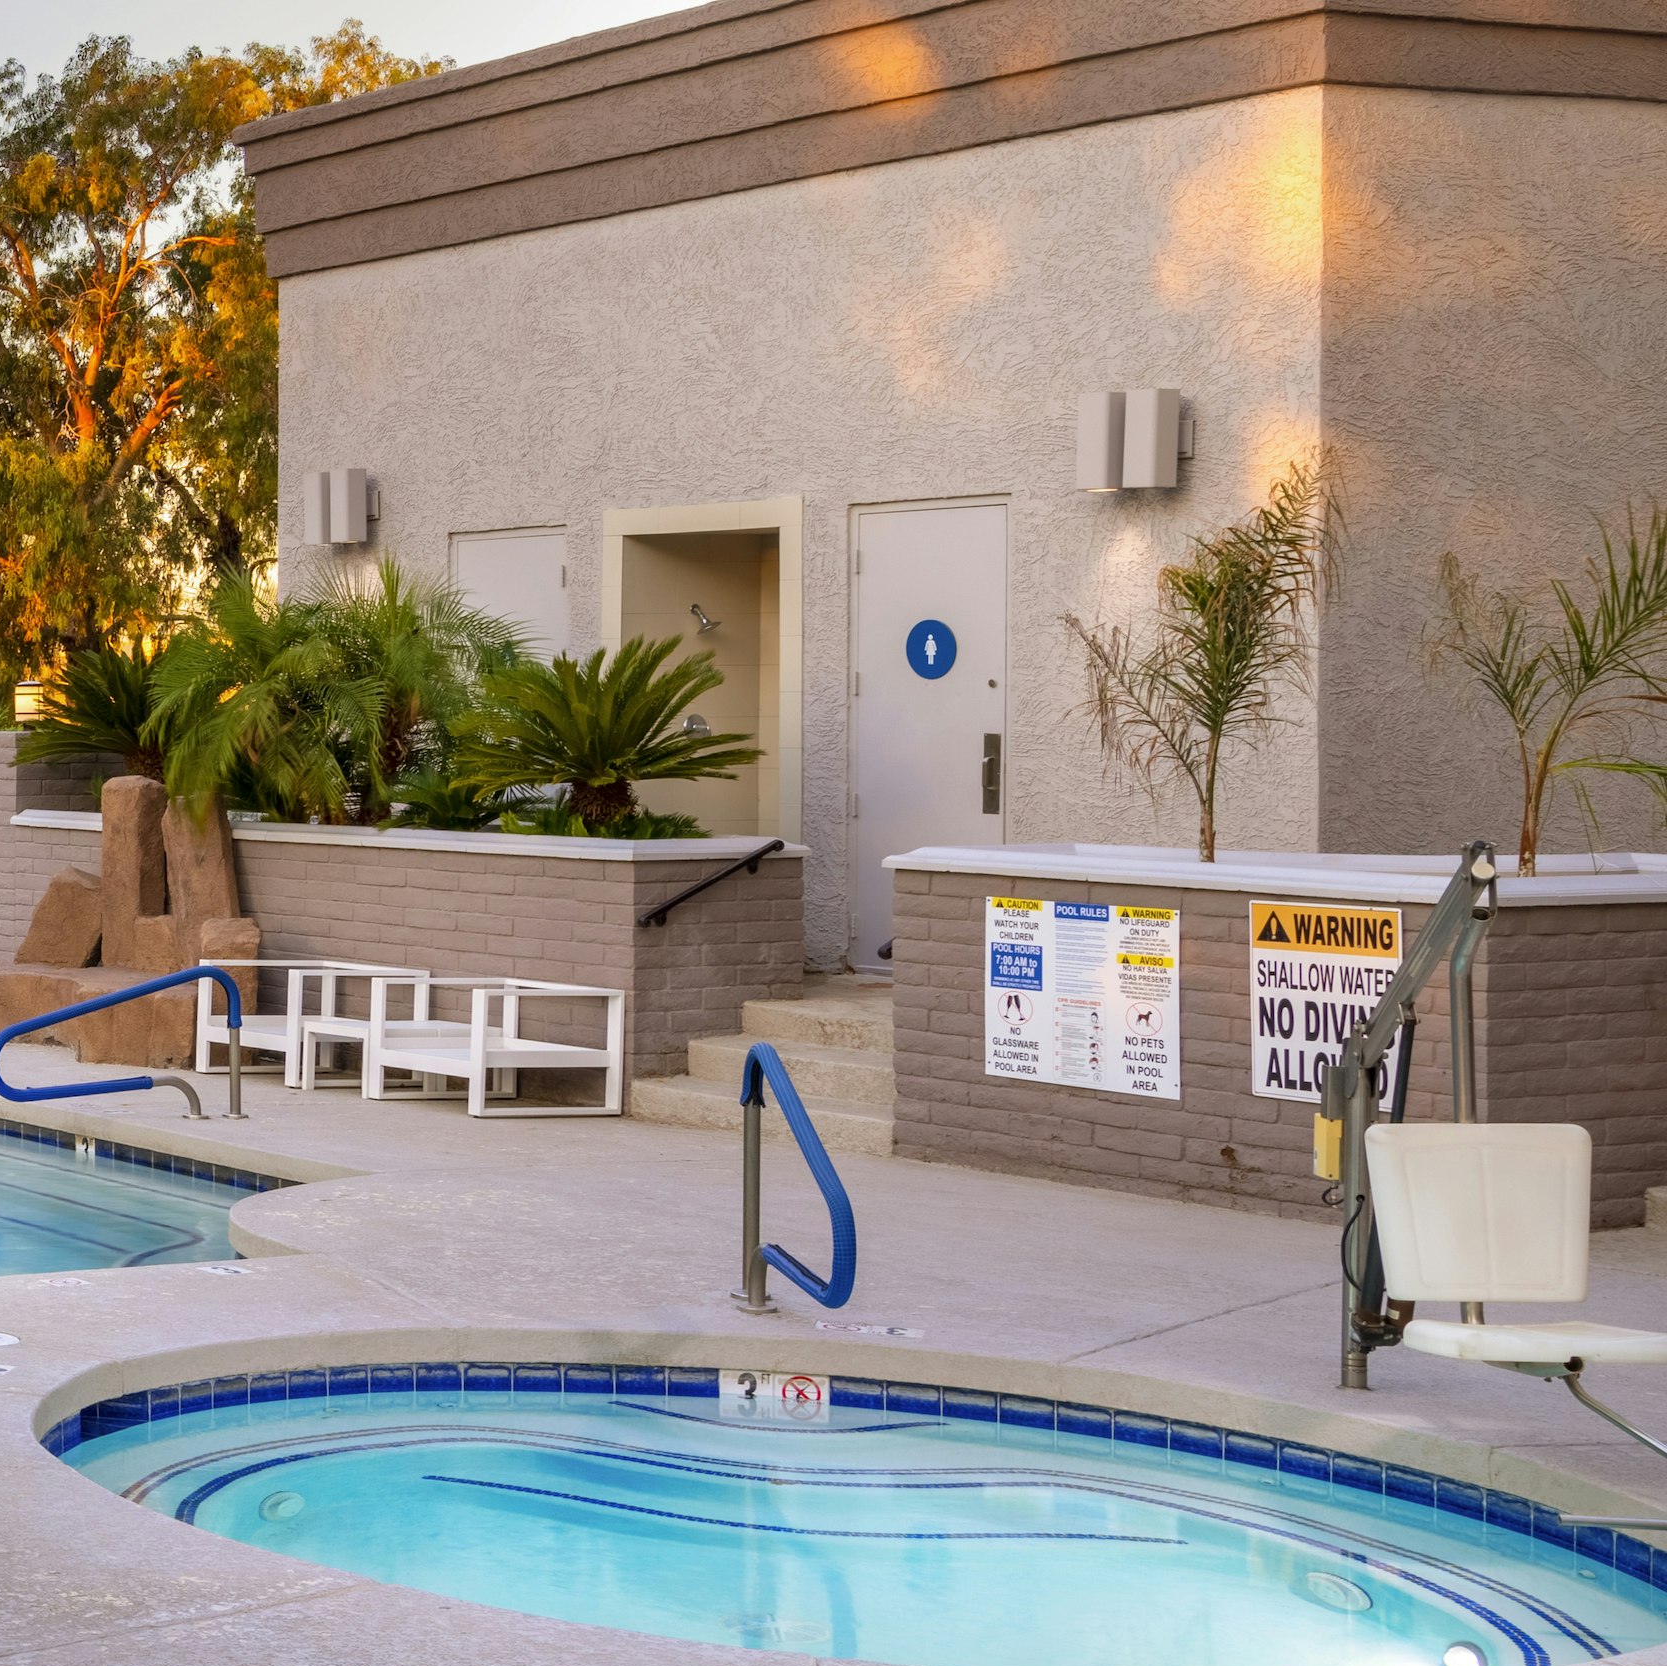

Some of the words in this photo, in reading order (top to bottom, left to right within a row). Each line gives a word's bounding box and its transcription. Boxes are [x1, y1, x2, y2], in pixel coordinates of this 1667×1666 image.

[1007, 900, 1038, 910] CAUTION
[1056, 905, 1079, 916] POOL
[1080, 906, 1107, 918] RULES
[1003, 909, 1030, 918] PLEASE
[1132, 908, 1171, 920] WARNING
[994, 920, 1018, 929] WATCH
[1020, 922, 1039, 930] YOUR
[1120, 917, 1130, 925] NO
[1131, 918, 1170, 928] LIFEGUARD
[999, 931, 1034, 941] CHILDREN
[1129, 928, 1140, 936] ON
[1141, 929, 1159, 937] DUTY
[1293, 913, 1393, 951] WARNING
[993, 943, 1013, 953] POOL
[1014, 945, 1041, 956] HOURS
[995, 955, 1013, 966] 7:00
[1013, 956, 1027, 967] AM
[1029, 958, 1038, 968] to
[1140, 956, 1164, 967] AVISO
[999, 965, 1020, 976] 10:00
[1021, 967, 1035, 978] PM
[1133, 965, 1146, 973] HAY
[1147, 966, 1168, 975] SALVA
[1257, 959, 1335, 992] SHALLOW
[1118, 973, 1137, 982] VIDAS
[1138, 974, 1172, 985] PRESENTE
[1259, 996, 1294, 1040] NO
[1010, 1026, 1021, 1036] NO
[992, 1036, 1039, 1051] GLASSWARE
[1125, 1036, 1138, 1046] NO
[1141, 1037, 1164, 1049] PETS
[993, 1049, 1029, 1062] ALLOWED
[1031, 1053, 1039, 1062] IN
[1122, 1050, 1168, 1064] ALLOWED
[995, 1062, 1015, 1072] POOL
[1017, 1064, 1038, 1075] AREA
[1127, 1064, 1135, 1075] IN
[1138, 1066, 1163, 1078] POOL
[1132, 1080, 1158, 1092] AREA
